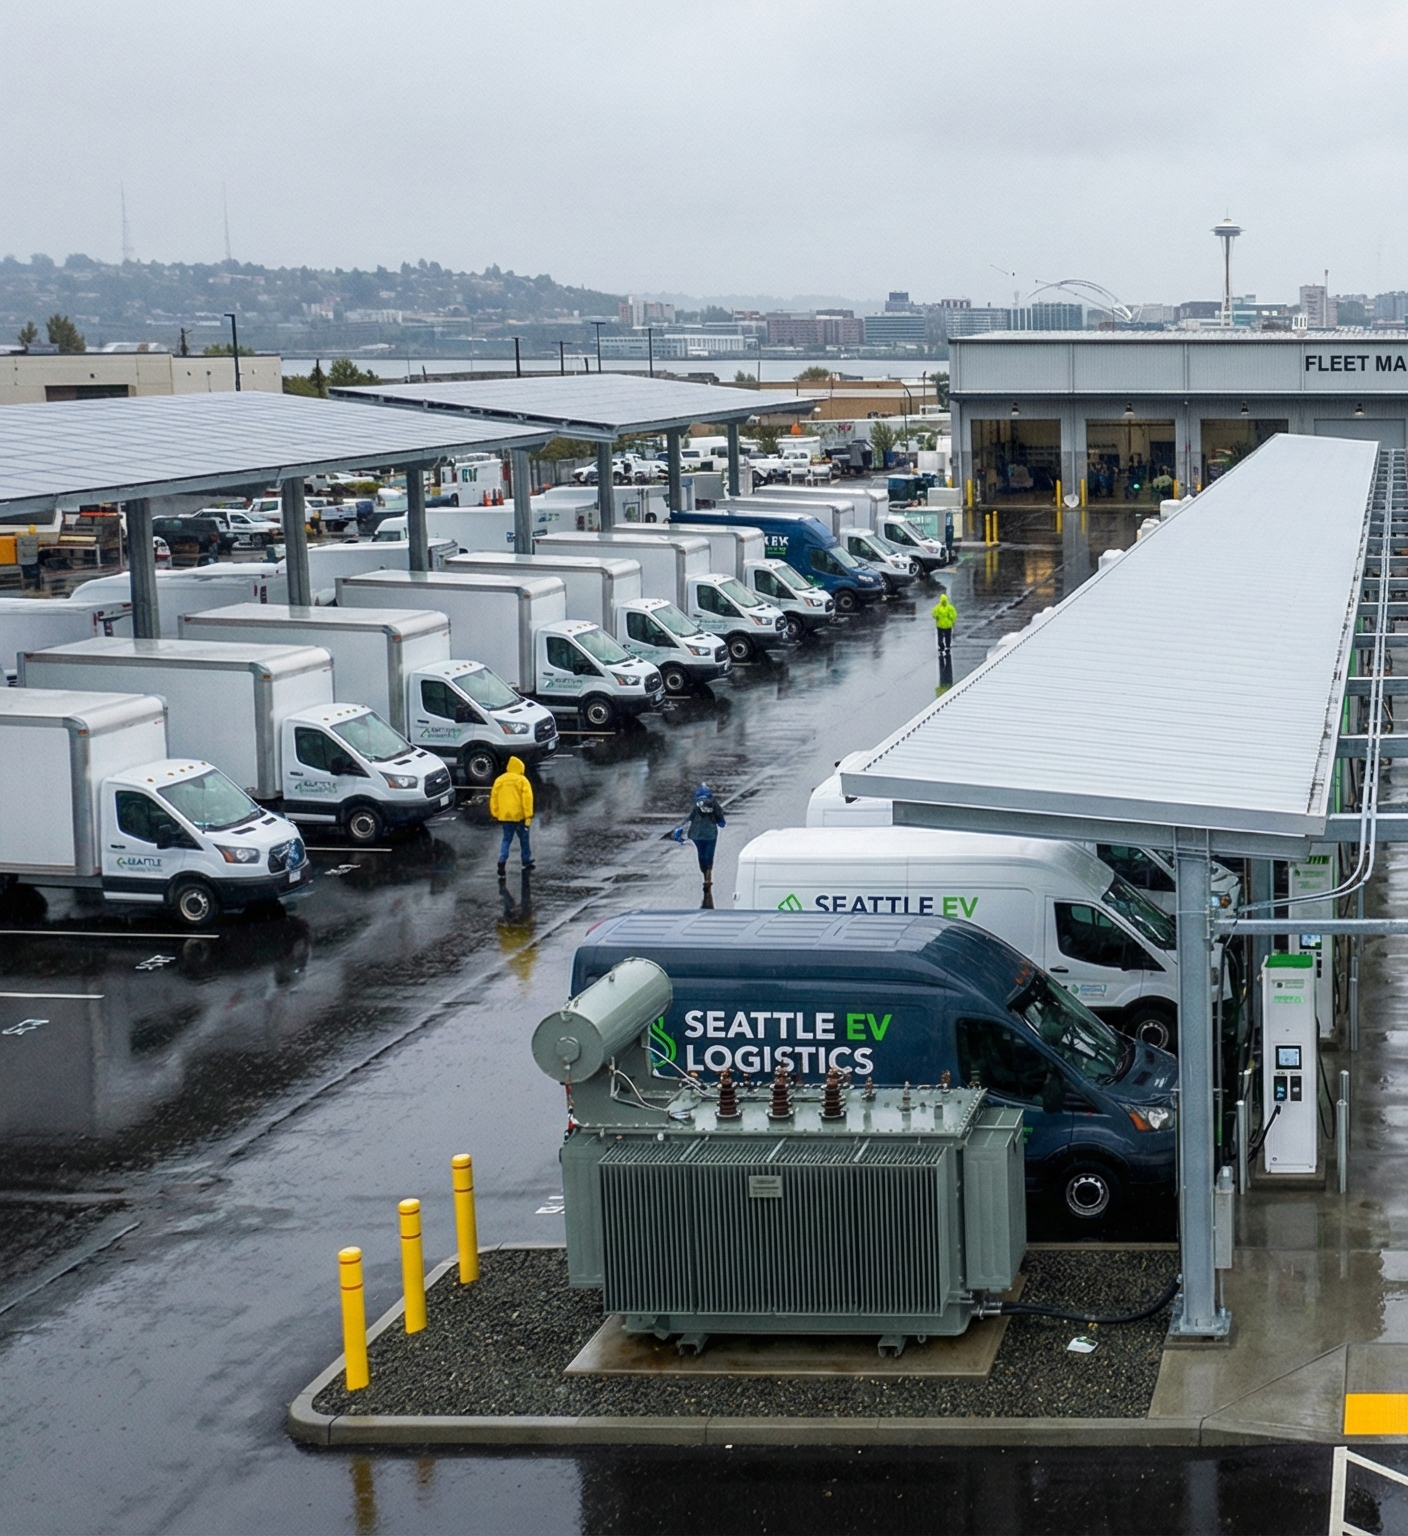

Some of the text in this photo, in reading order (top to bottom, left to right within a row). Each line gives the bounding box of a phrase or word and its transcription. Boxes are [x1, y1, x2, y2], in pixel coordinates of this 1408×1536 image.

[1305, 355, 1370, 372] FLEET
[942, 896, 979, 918] EV
[684, 1010, 893, 1041] SEATTLE EV
[686, 1044, 874, 1075] LOGISTICS
